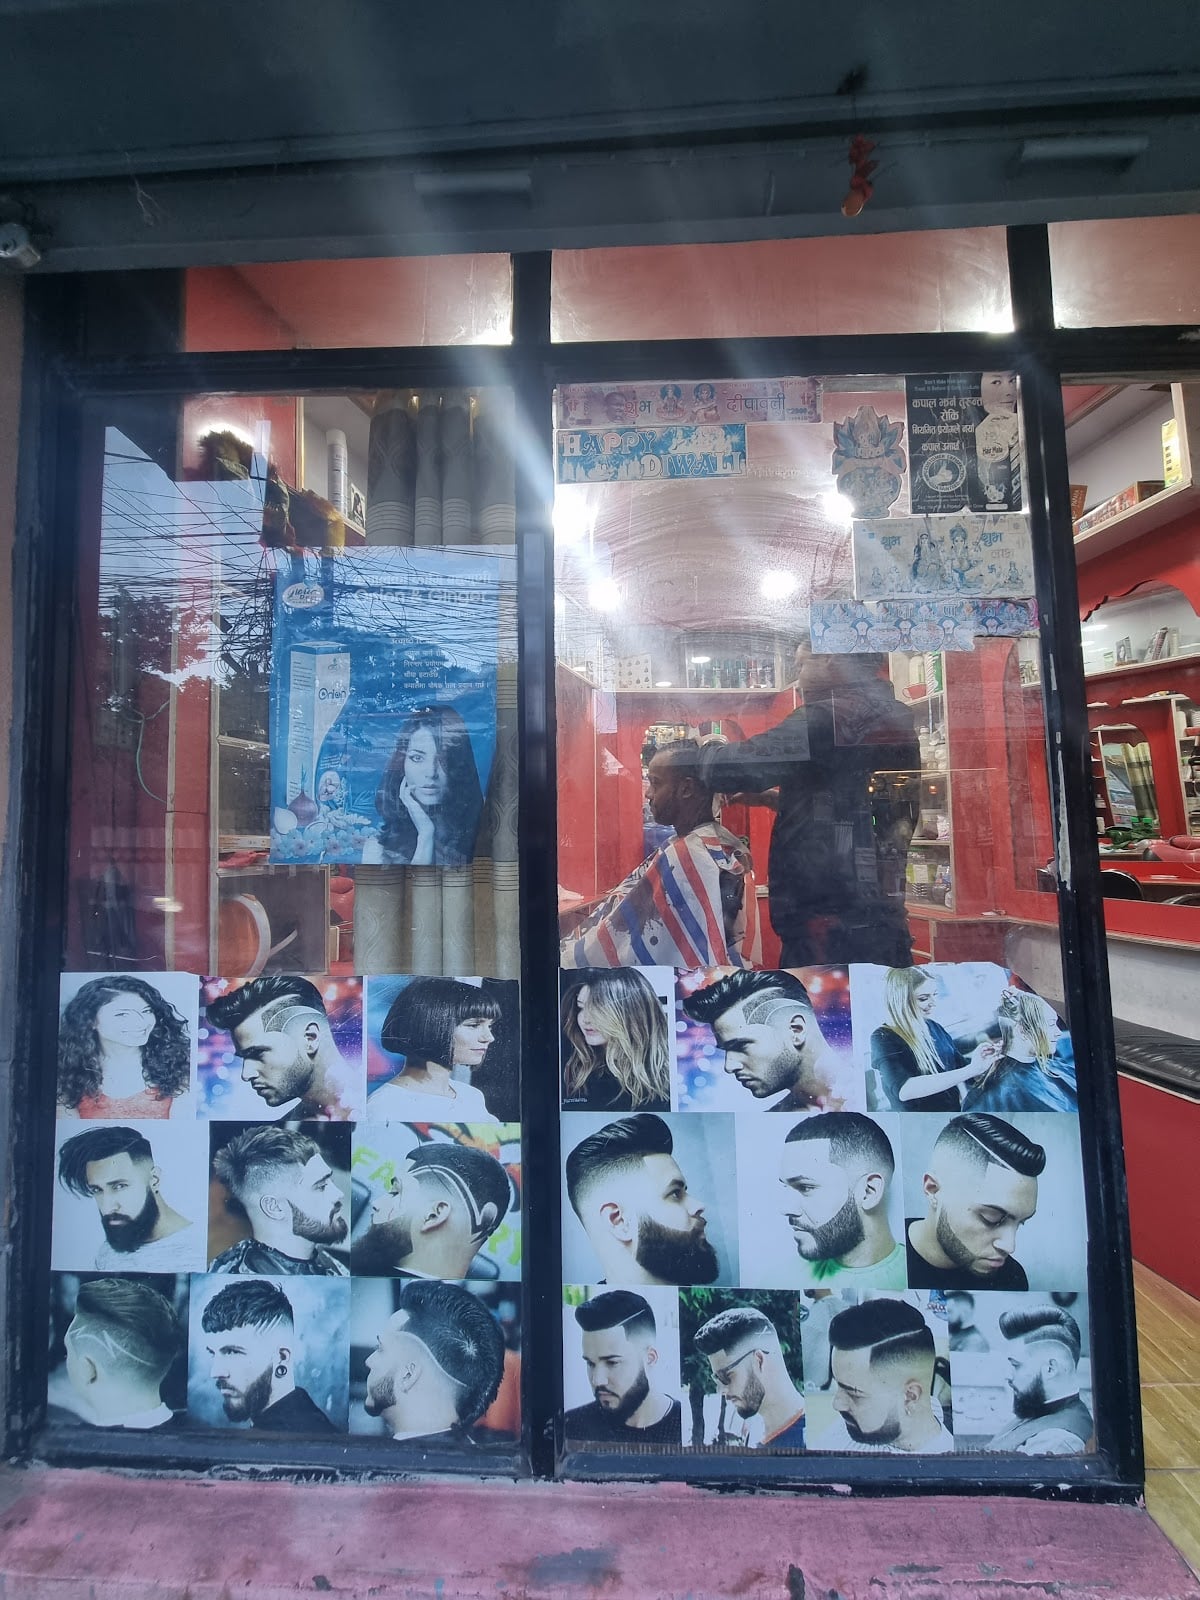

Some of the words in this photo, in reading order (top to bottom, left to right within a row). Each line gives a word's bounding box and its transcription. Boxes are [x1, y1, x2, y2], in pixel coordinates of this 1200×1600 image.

[912, 398, 937, 408] कपाल
[562, 430, 657, 457] HAPPY
[641, 451, 743, 478] DIWALI
